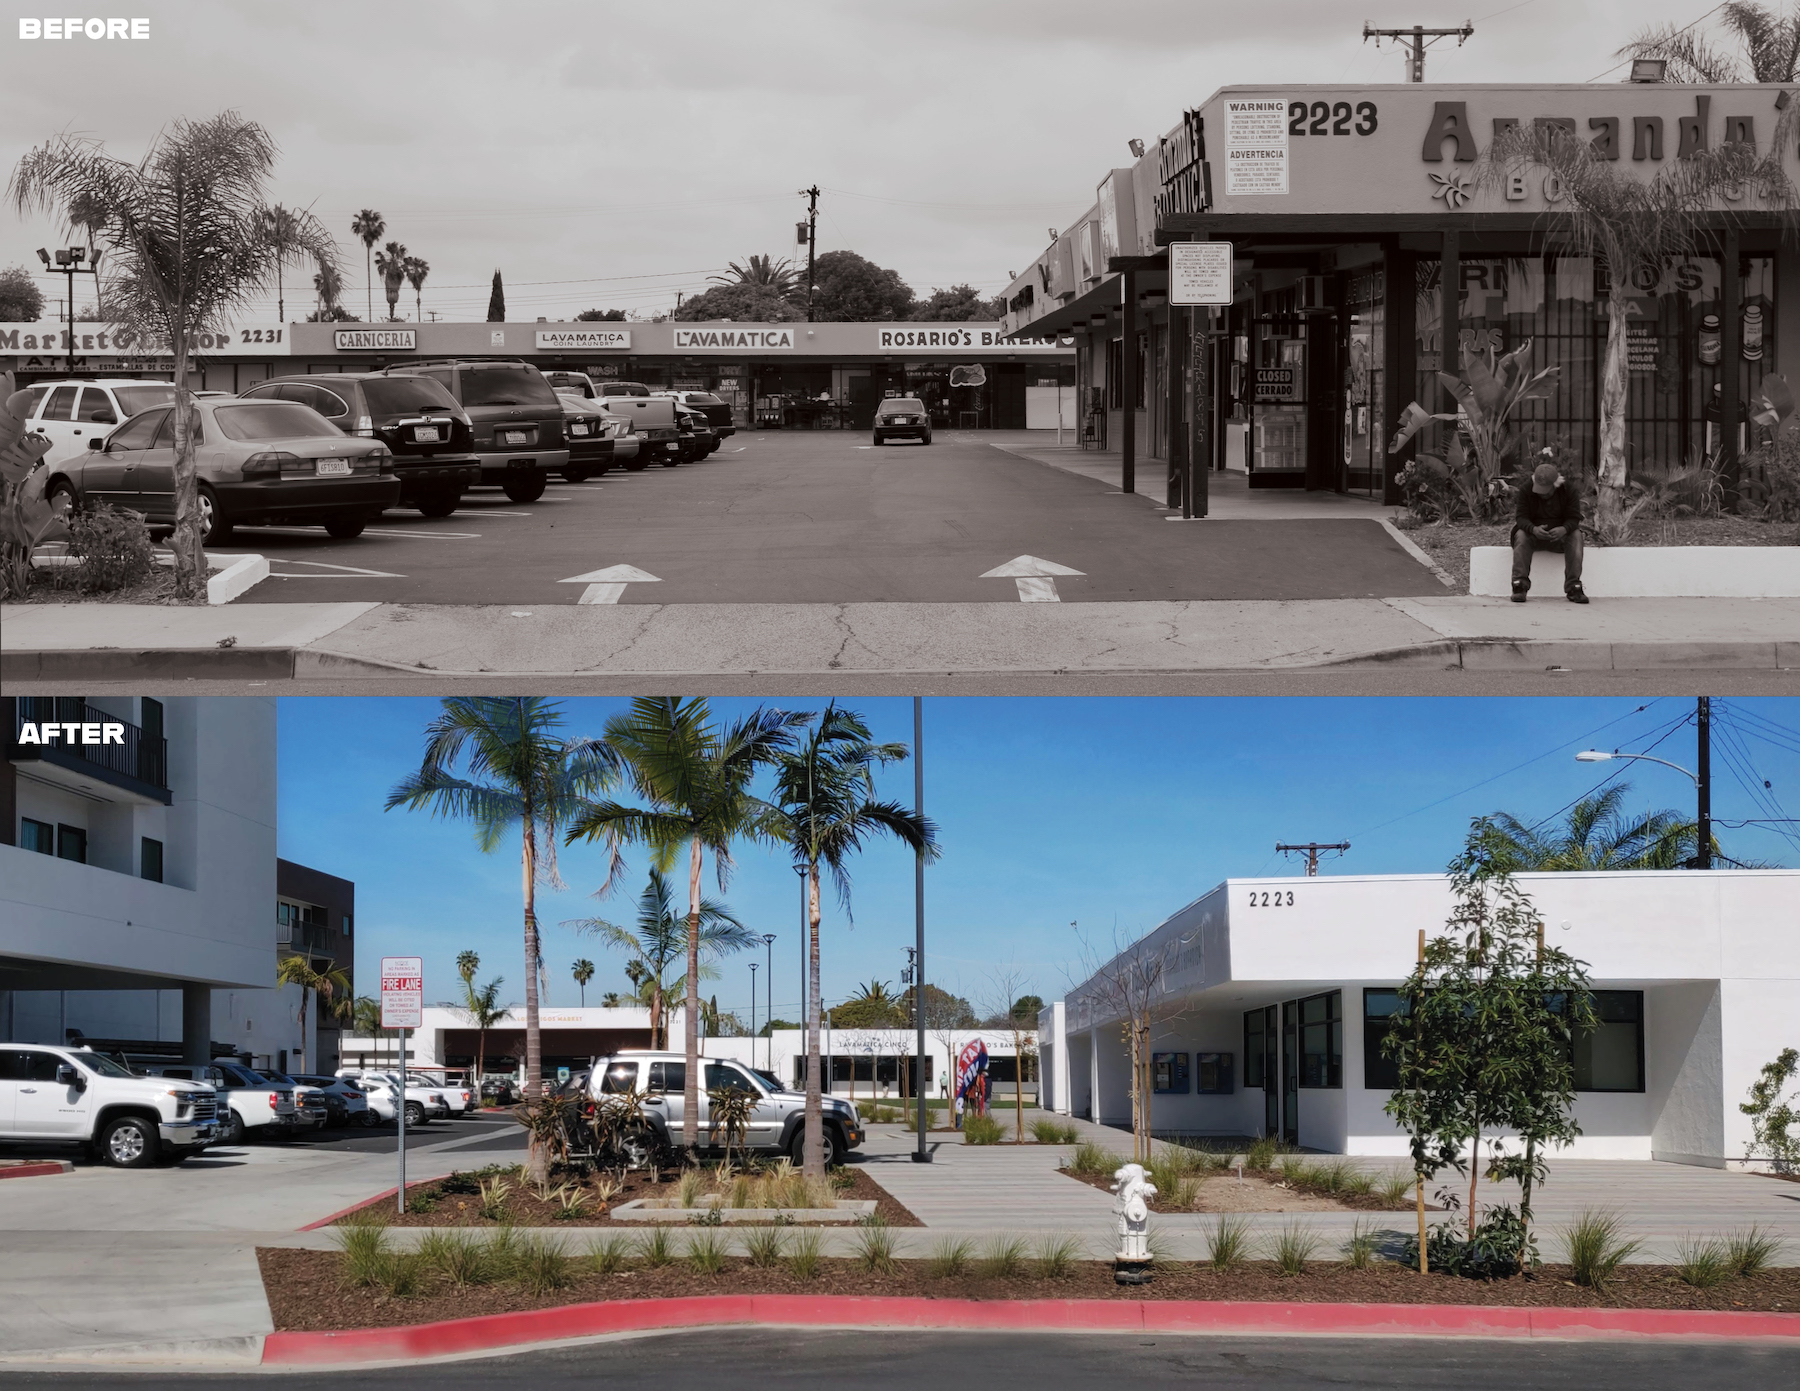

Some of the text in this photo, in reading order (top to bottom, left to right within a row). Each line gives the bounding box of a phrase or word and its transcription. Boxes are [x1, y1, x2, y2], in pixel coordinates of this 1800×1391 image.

[1229, 103, 1283, 111] WARNING
[1288, 101, 1378, 136] 2223
[1230, 150, 1284, 159] ADVERTENCIA
[241, 329, 282, 343] 2231
[339, 331, 413, 348] CARNICERIA
[542, 333, 624, 342] LAVAMATICA
[881, 328, 972, 347] ROSARIO'S
[587, 366, 619, 376] WASH
[718, 366, 742, 376] DRY
[1256, 370, 1291, 382] CLOSED
[1256, 385, 1292, 395] CERRADO
[1249, 891, 1294, 907] 2223
[383, 978, 421, 990] FIRE LANE
